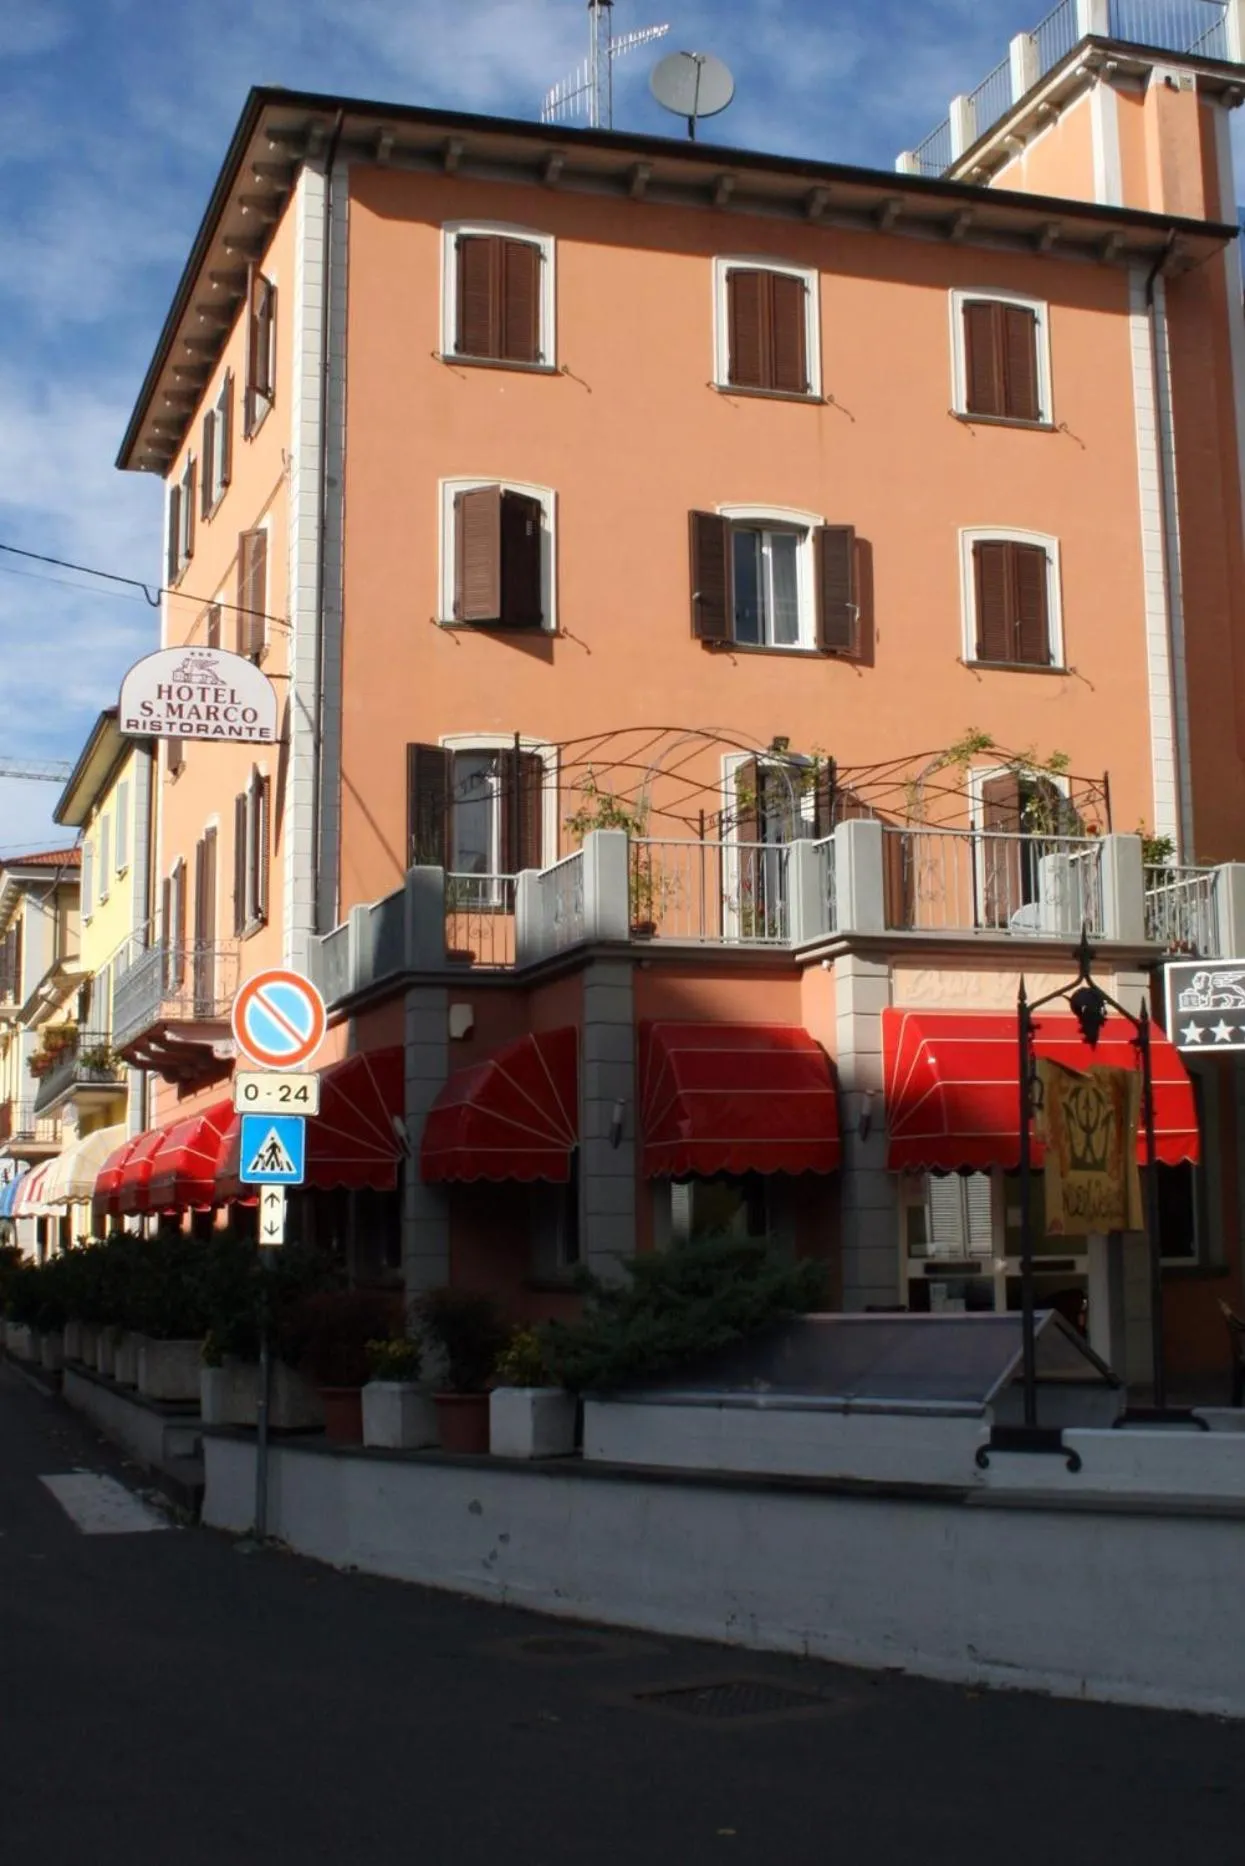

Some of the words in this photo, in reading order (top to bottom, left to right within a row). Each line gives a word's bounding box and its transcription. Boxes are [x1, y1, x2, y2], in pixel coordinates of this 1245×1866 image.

[156, 683, 242, 705] HOTEL
[126, 718, 271, 738] RISTORANTE
[278, 1085, 310, 1103] 24
